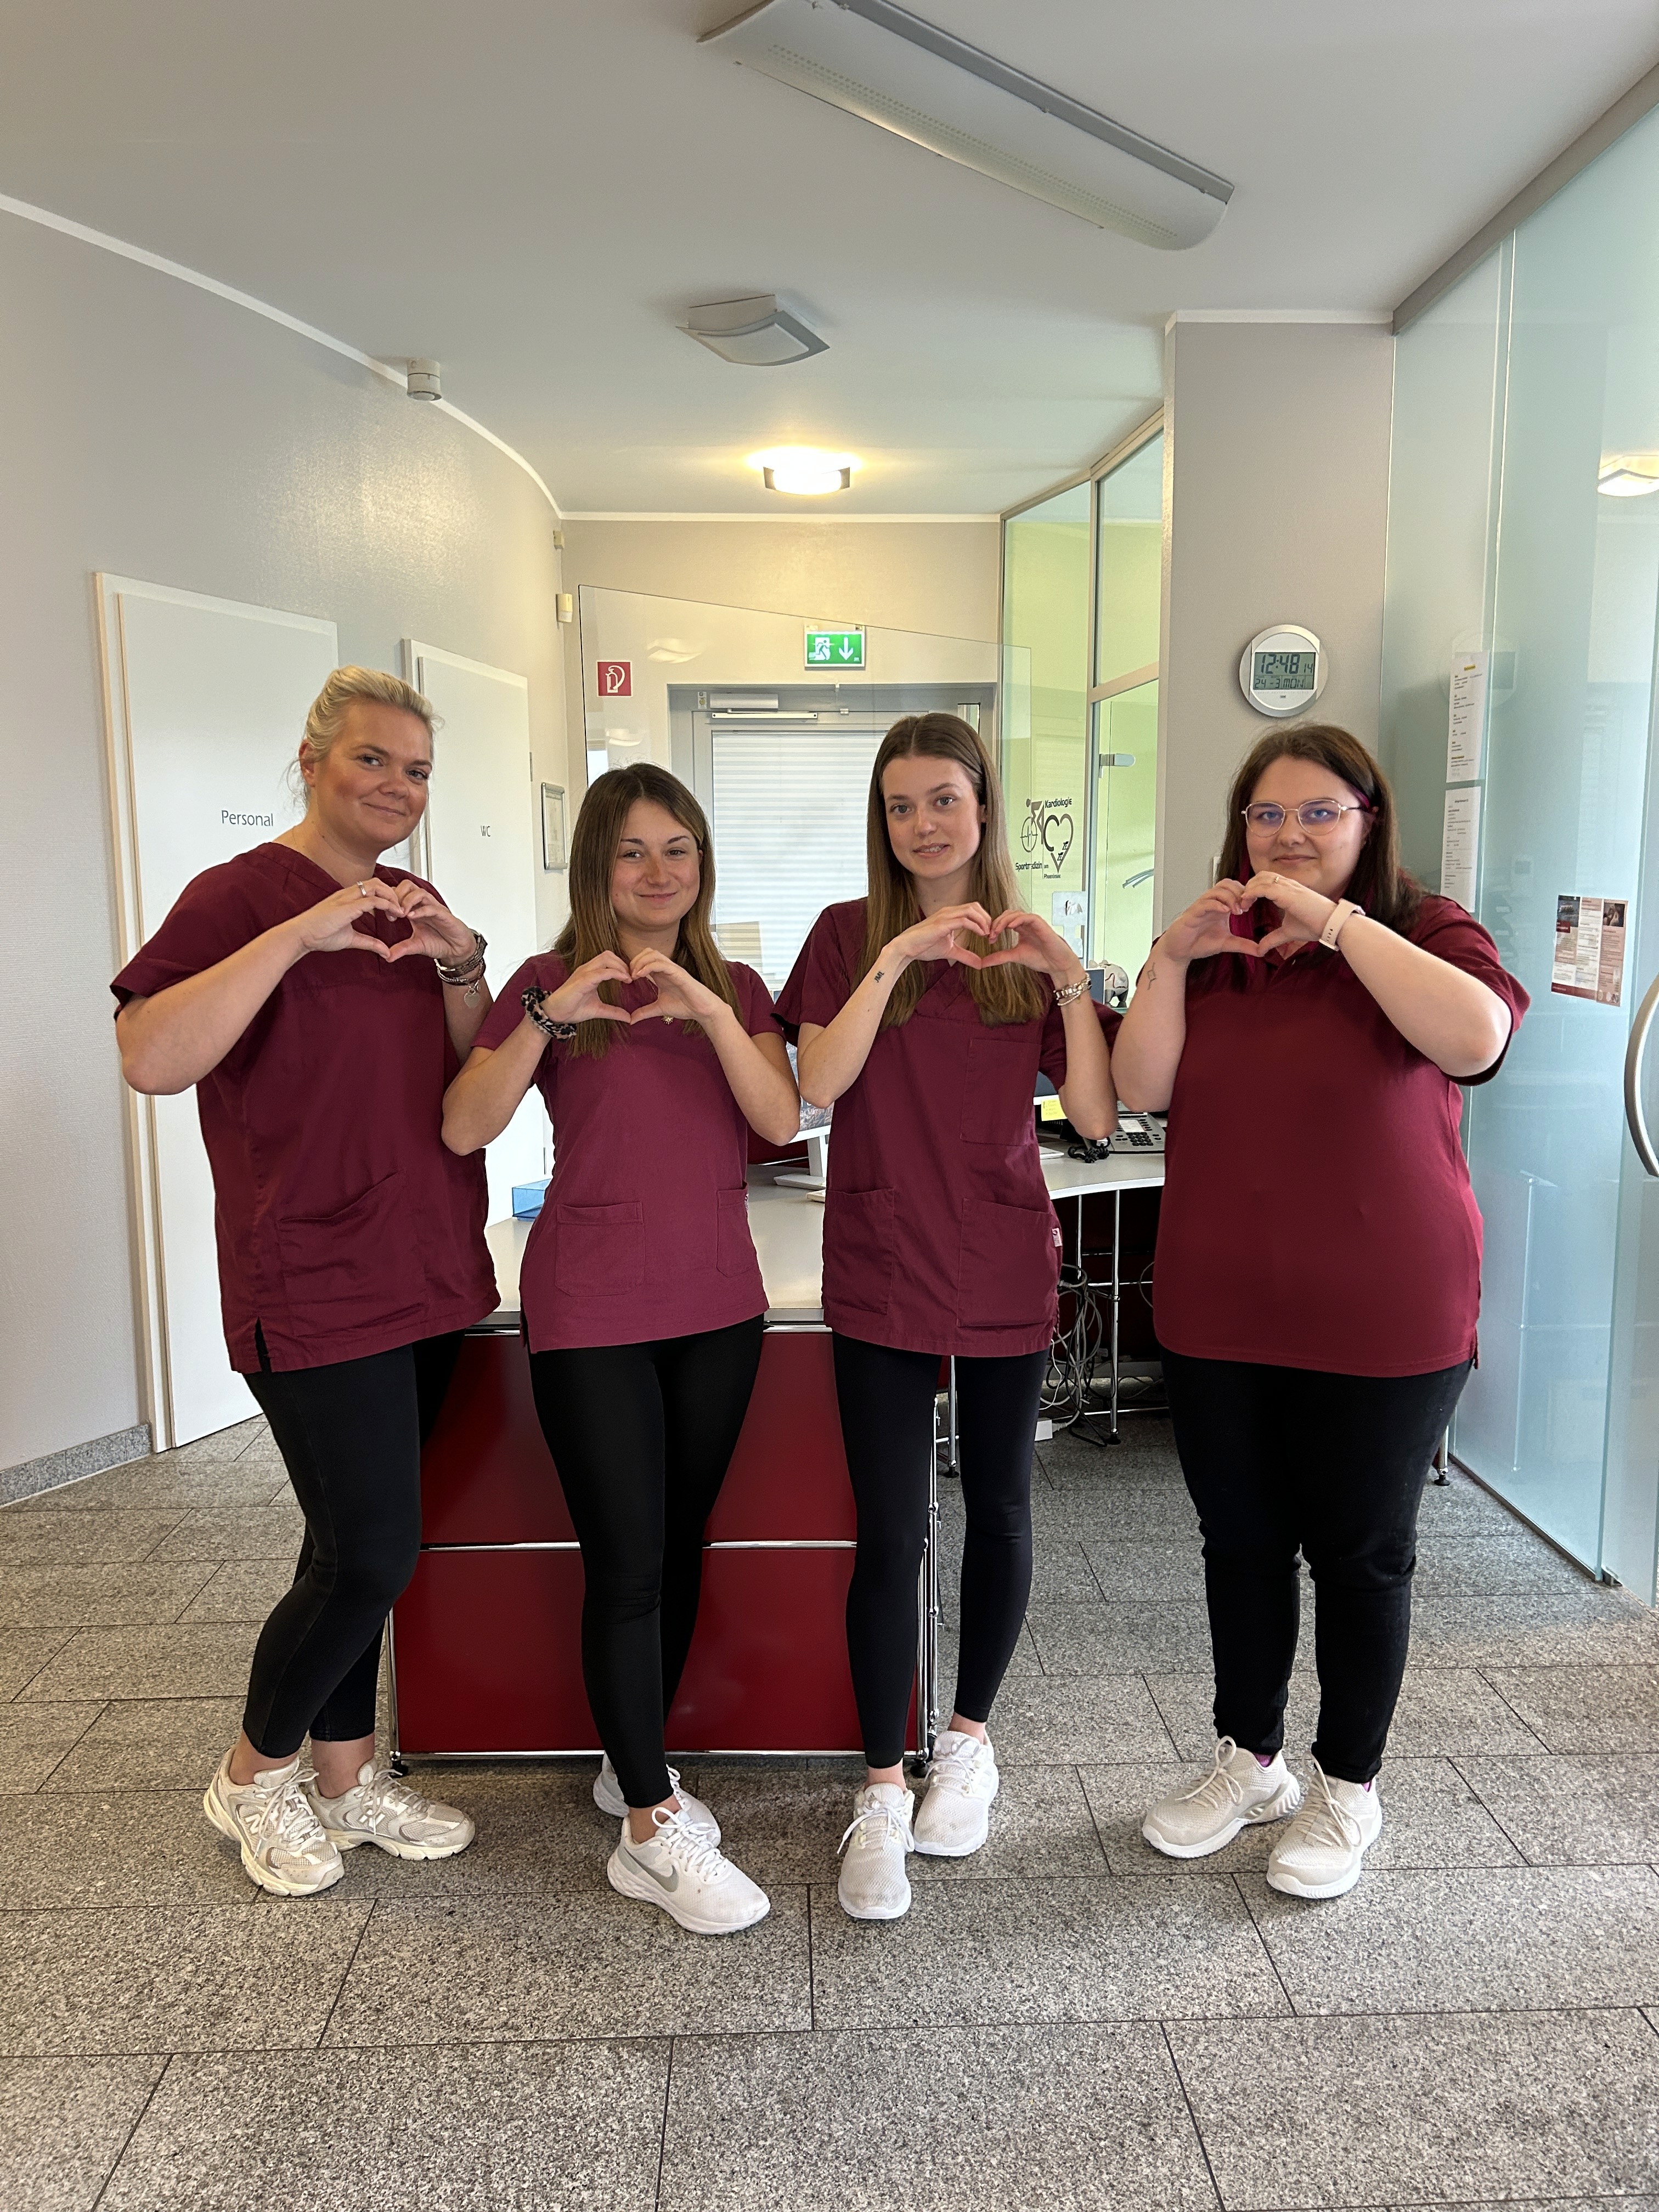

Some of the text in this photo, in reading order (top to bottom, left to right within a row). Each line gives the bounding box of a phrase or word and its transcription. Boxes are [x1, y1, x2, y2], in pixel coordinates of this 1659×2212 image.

[1261, 653, 1313, 674] 12:48 14
[1255, 678, 1266, 689] 24
[1283, 678, 1304, 689] MON
[1045, 797, 1072, 809] Kardiologie
[221, 810, 274, 827] Personal
[480, 825, 491, 837] WC
